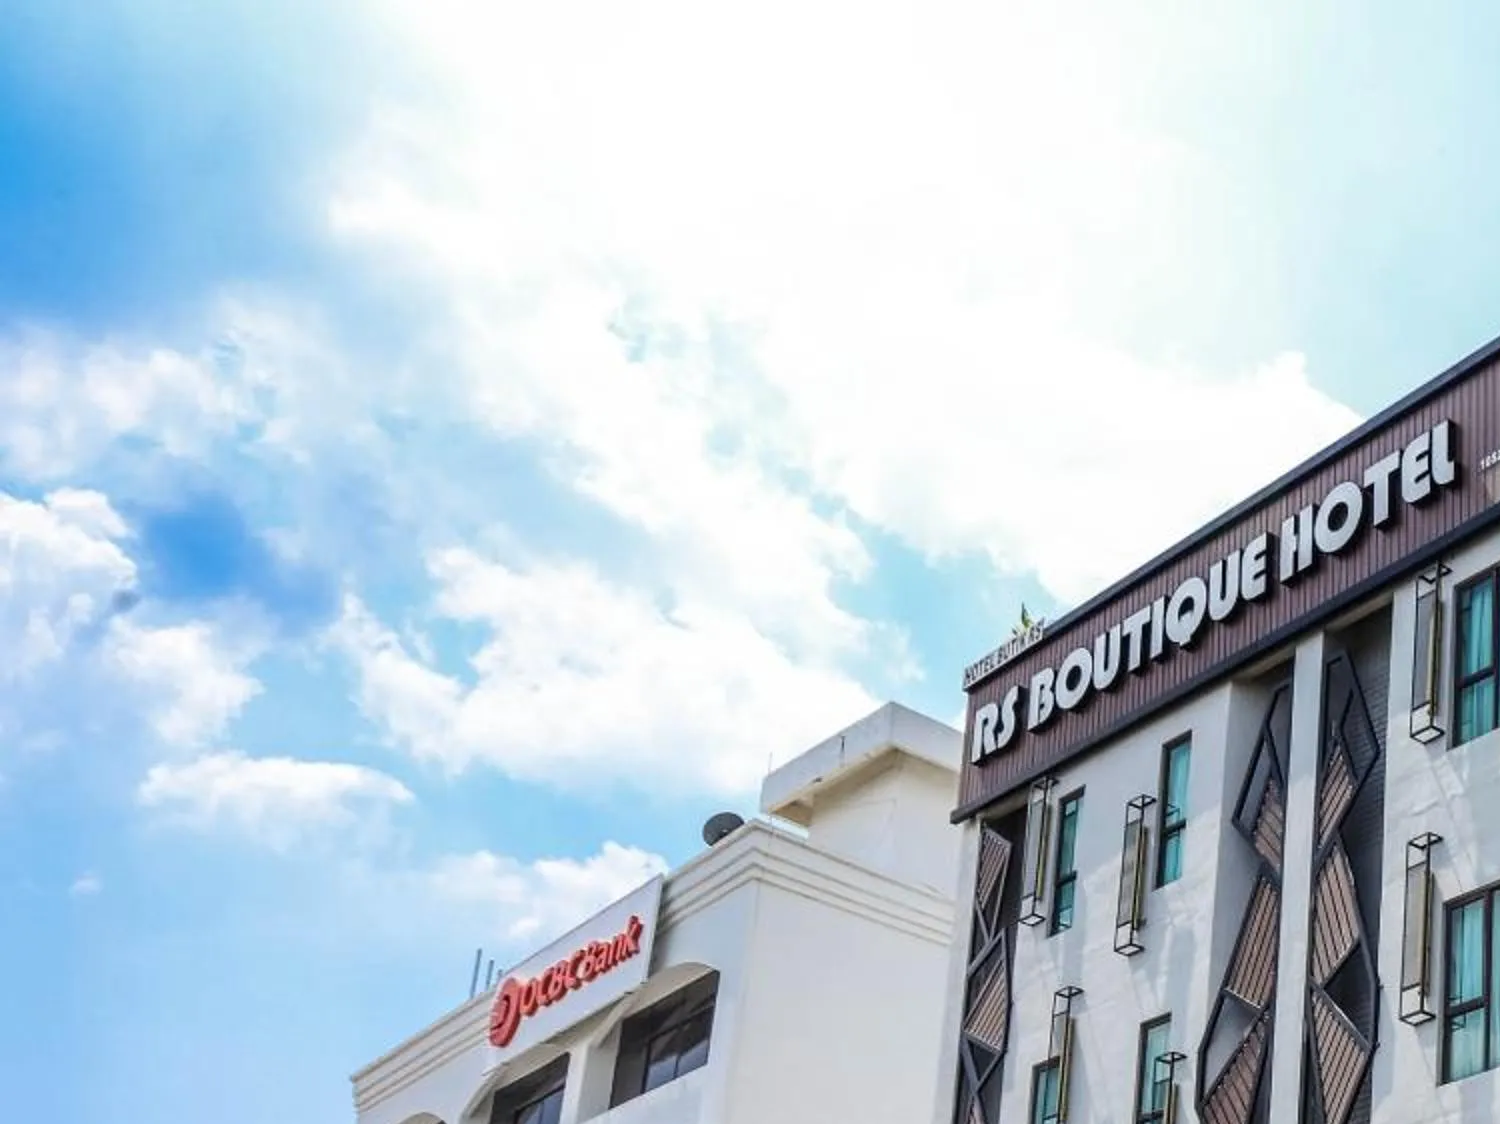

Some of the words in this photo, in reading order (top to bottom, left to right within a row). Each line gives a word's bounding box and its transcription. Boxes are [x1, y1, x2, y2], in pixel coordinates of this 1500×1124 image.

[971, 685, 1019, 765] RS
[1028, 535, 1268, 733] BOUTIQUE
[1279, 419, 1456, 583] HOTEL
[520, 950, 583, 1017] OCBC
[578, 916, 644, 983] Bank
